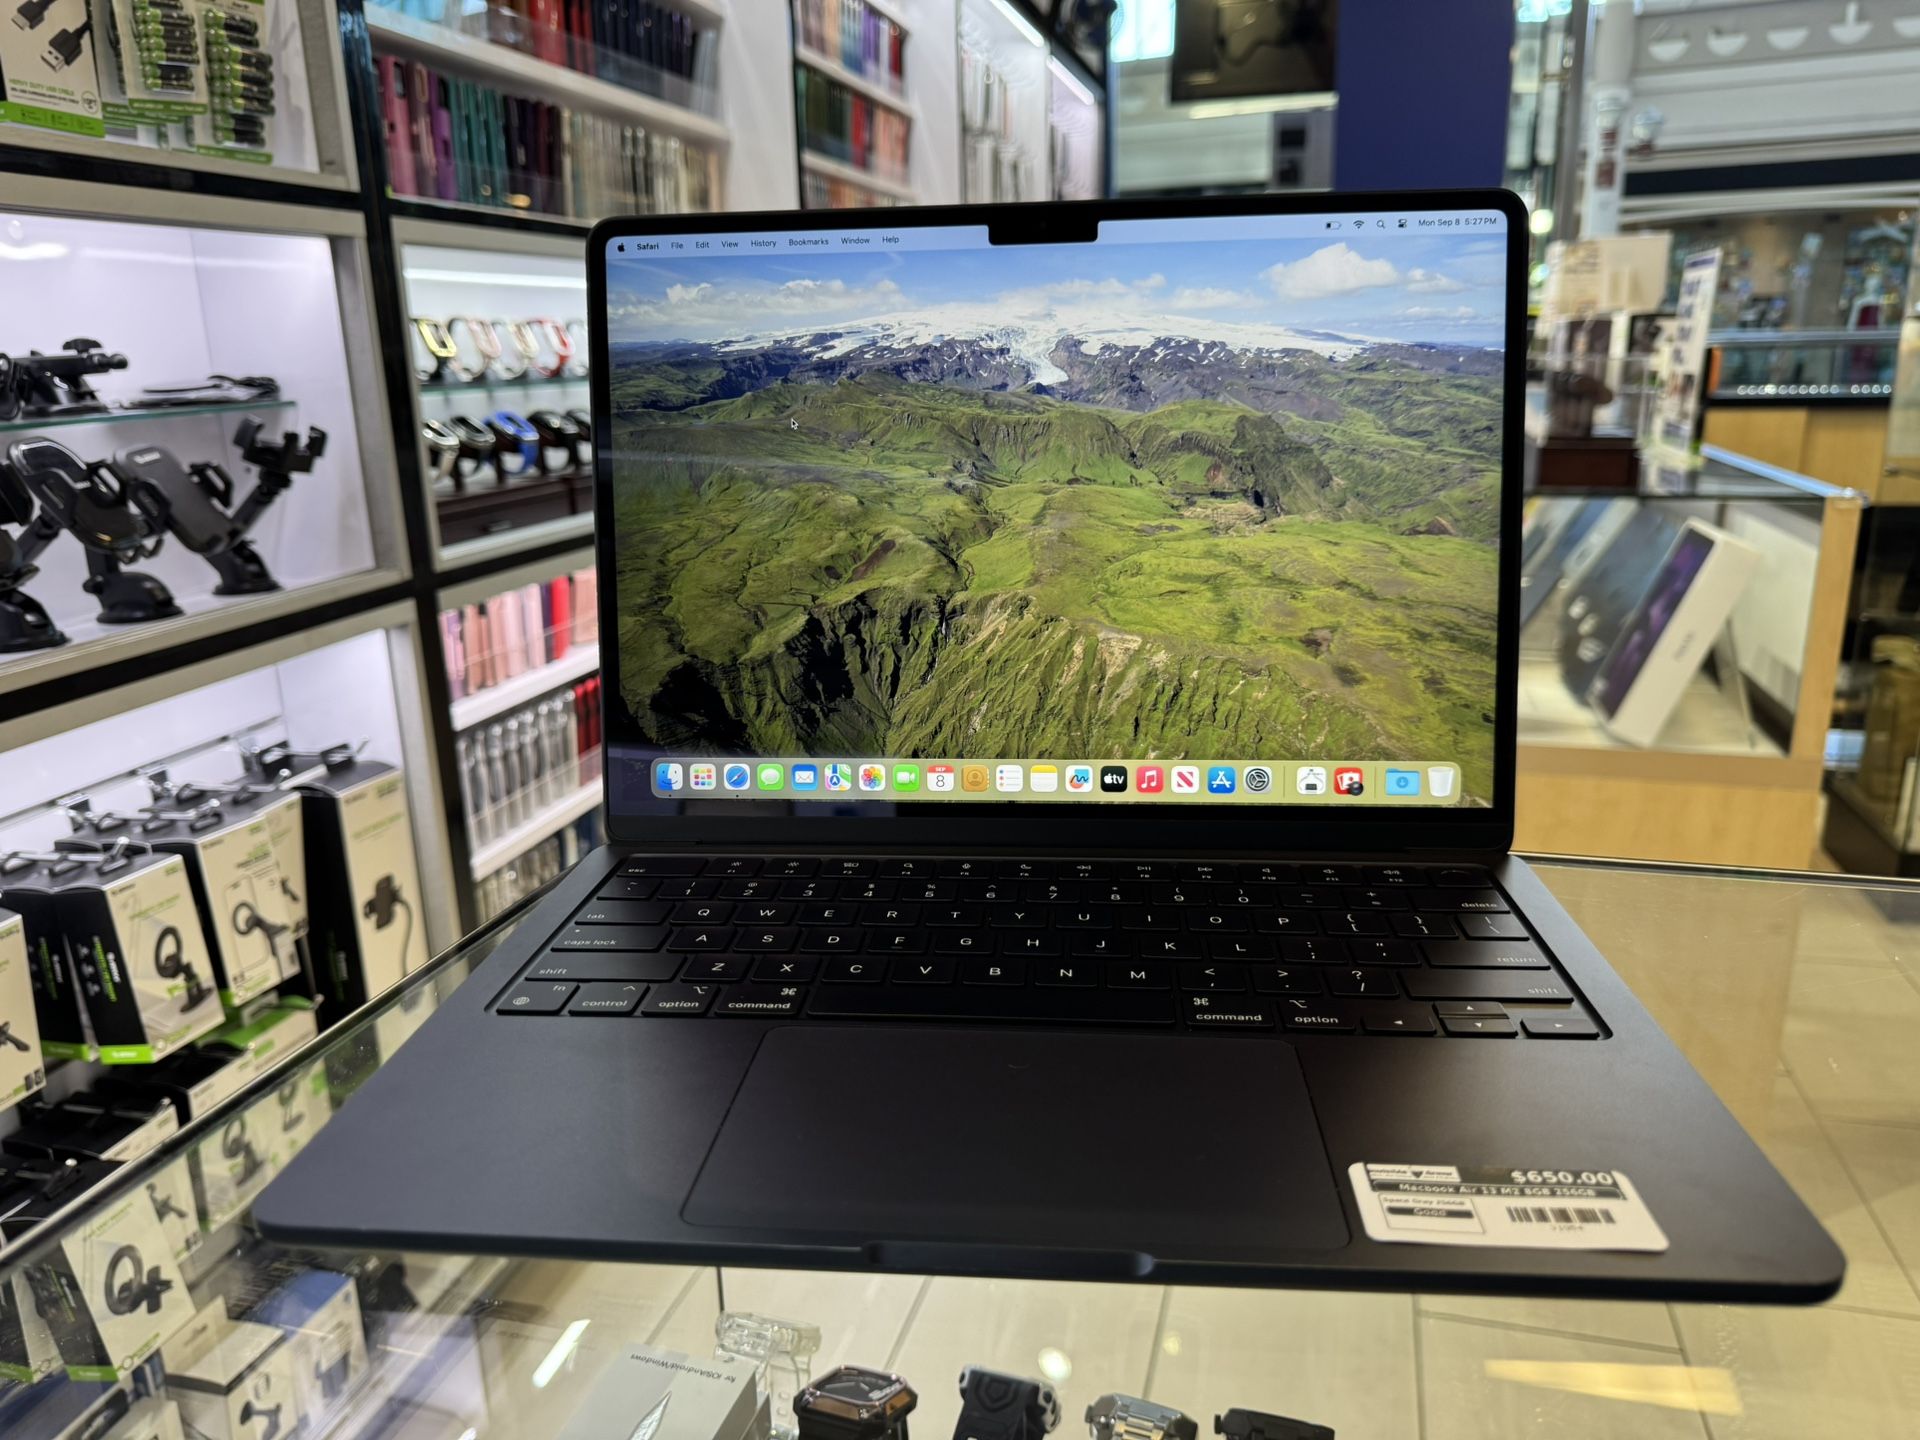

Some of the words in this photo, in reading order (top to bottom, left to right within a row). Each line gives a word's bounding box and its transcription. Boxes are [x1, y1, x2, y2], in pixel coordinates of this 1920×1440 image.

[1418, 219, 1436, 227] Mon
[1437, 218, 1453, 228] Sep
[1454, 218, 1460, 226] 8
[1464, 217, 1483, 226] 5:27
[1483, 217, 1497, 225] PM
[636, 242, 660, 251] Safari
[670, 241, 684, 250] File
[695, 240, 710, 249] Edit
[721, 240, 739, 248] View
[750, 239, 777, 248] History
[788, 238, 829, 247] Bookmarks
[840, 236, 871, 245] Window
[882, 235, 900, 244] Help
[935, 774, 945, 788] 8
[1112, 773, 1124, 785] tv
[685, 888, 692, 896] 1
[742, 888, 754, 896] 2
[802, 889, 814, 897] 3
[863, 890, 873, 898] 4
[924, 890, 935, 898] 5
[985, 891, 996, 899] 6
[1048, 892, 1058, 900] 7
[1110, 893, 1121, 901] 8
[1173, 894, 1185, 903] 9
[1461, 901, 1498, 909] delete
[697, 908, 711, 917] Q
[759, 908, 777, 917] W
[823, 909, 835, 918] E
[886, 910, 899, 919] R
[950, 911, 961, 919] T
[1014, 911, 1026, 920] Y
[1077, 913, 1091, 922] U
[1277, 917, 1290, 926] P
[593, 938, 617, 946] lock
[695, 933, 708, 943] A
[761, 934, 775, 944] S
[826, 935, 841, 944] D
[894, 936, 906, 945] F
[959, 937, 973, 946] G
[1026, 938, 1040, 948] H
[1095, 939, 1106, 949] J
[1164, 941, 1177, 951] K
[1234, 943, 1247, 952] L
[1496, 955, 1537, 963] return
[538, 967, 568, 976] shift
[711, 962, 726, 972] Z
[779, 963, 795, 973] X
[849, 964, 863, 974] C
[919, 965, 933, 975] V
[988, 966, 1002, 977] B
[1059, 968, 1073, 978] N
[1129, 970, 1147, 980] M
[552, 984, 567, 992] fn
[1527, 986, 1559, 995] shift
[581, 998, 628, 1008] control
[658, 1000, 700, 1010] option
[727, 1000, 791, 1010] command
[1195, 1012, 1263, 1023] command
[1294, 1014, 1339, 1025] option
[1510, 1169, 1614, 1186] $650.00
[1398, 1182, 1455, 1193] Macbook
[1459, 1185, 1478, 1194] Air
[1482, 1186, 1497, 1195] 13
[1501, 1187, 1520, 1195] M2
[1524, 1187, 1551, 1196] 8GB
[1555, 1188, 1597, 1197] 256GB
[1413, 1207, 1447, 1218] Good
